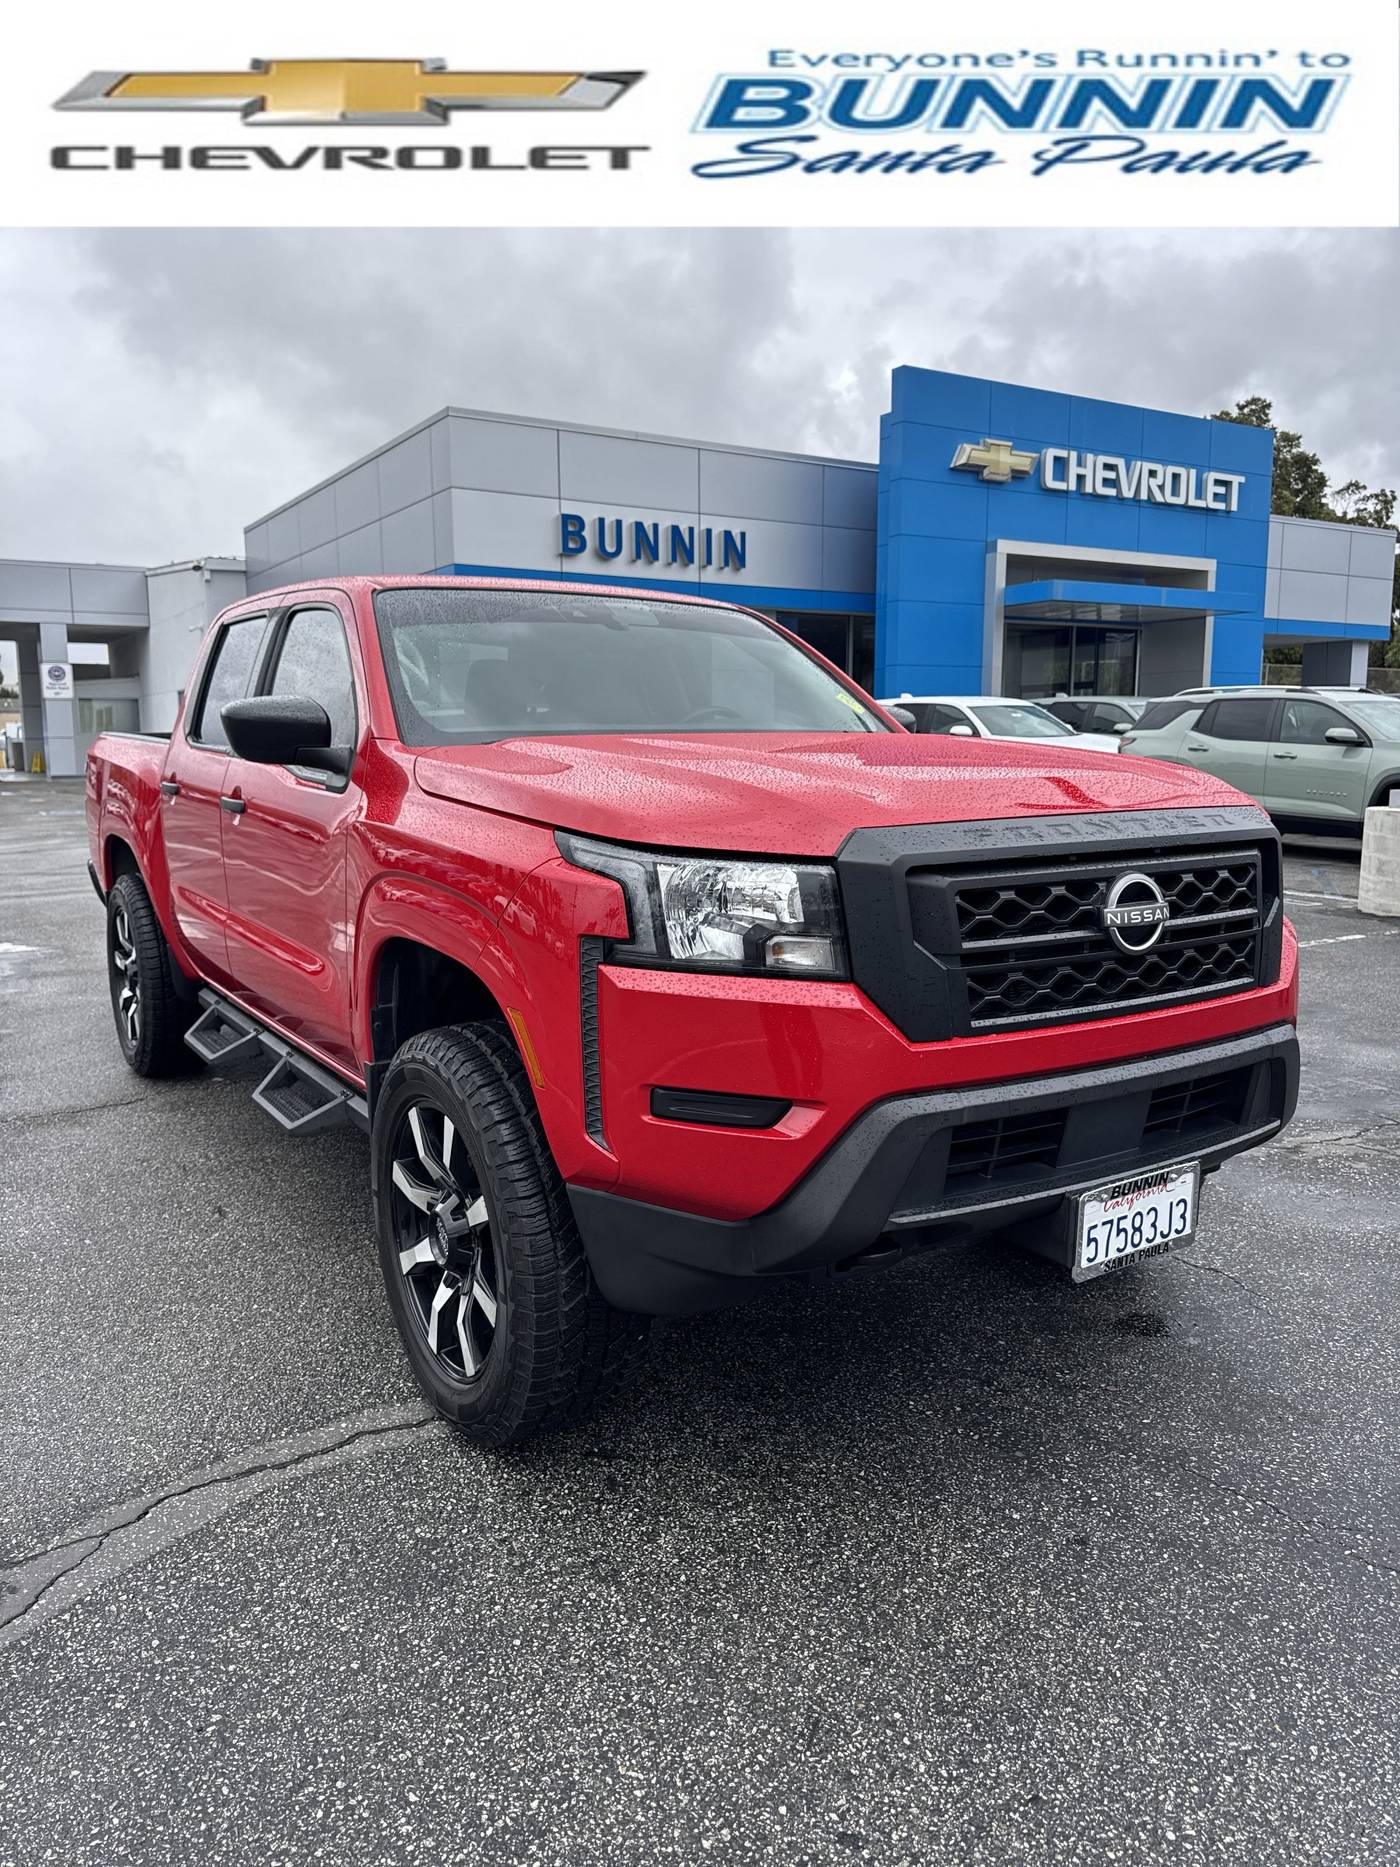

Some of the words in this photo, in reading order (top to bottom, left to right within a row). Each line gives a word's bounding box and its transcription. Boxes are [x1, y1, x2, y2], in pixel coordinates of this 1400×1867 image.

[1041, 448, 1246, 512] CHEVROLET
[560, 513, 746, 569] BUNNIN
[962, 813, 1235, 841] FRONTIER
[1107, 907, 1170, 925] NISSAN
[1103, 1183, 1175, 1213] California
[1110, 1171, 1170, 1200] BUNNIN
[1086, 1198, 1188, 1263] 57583J3
[1103, 1253, 1136, 1273] SANTA
[1138, 1242, 1169, 1262] PAULA
